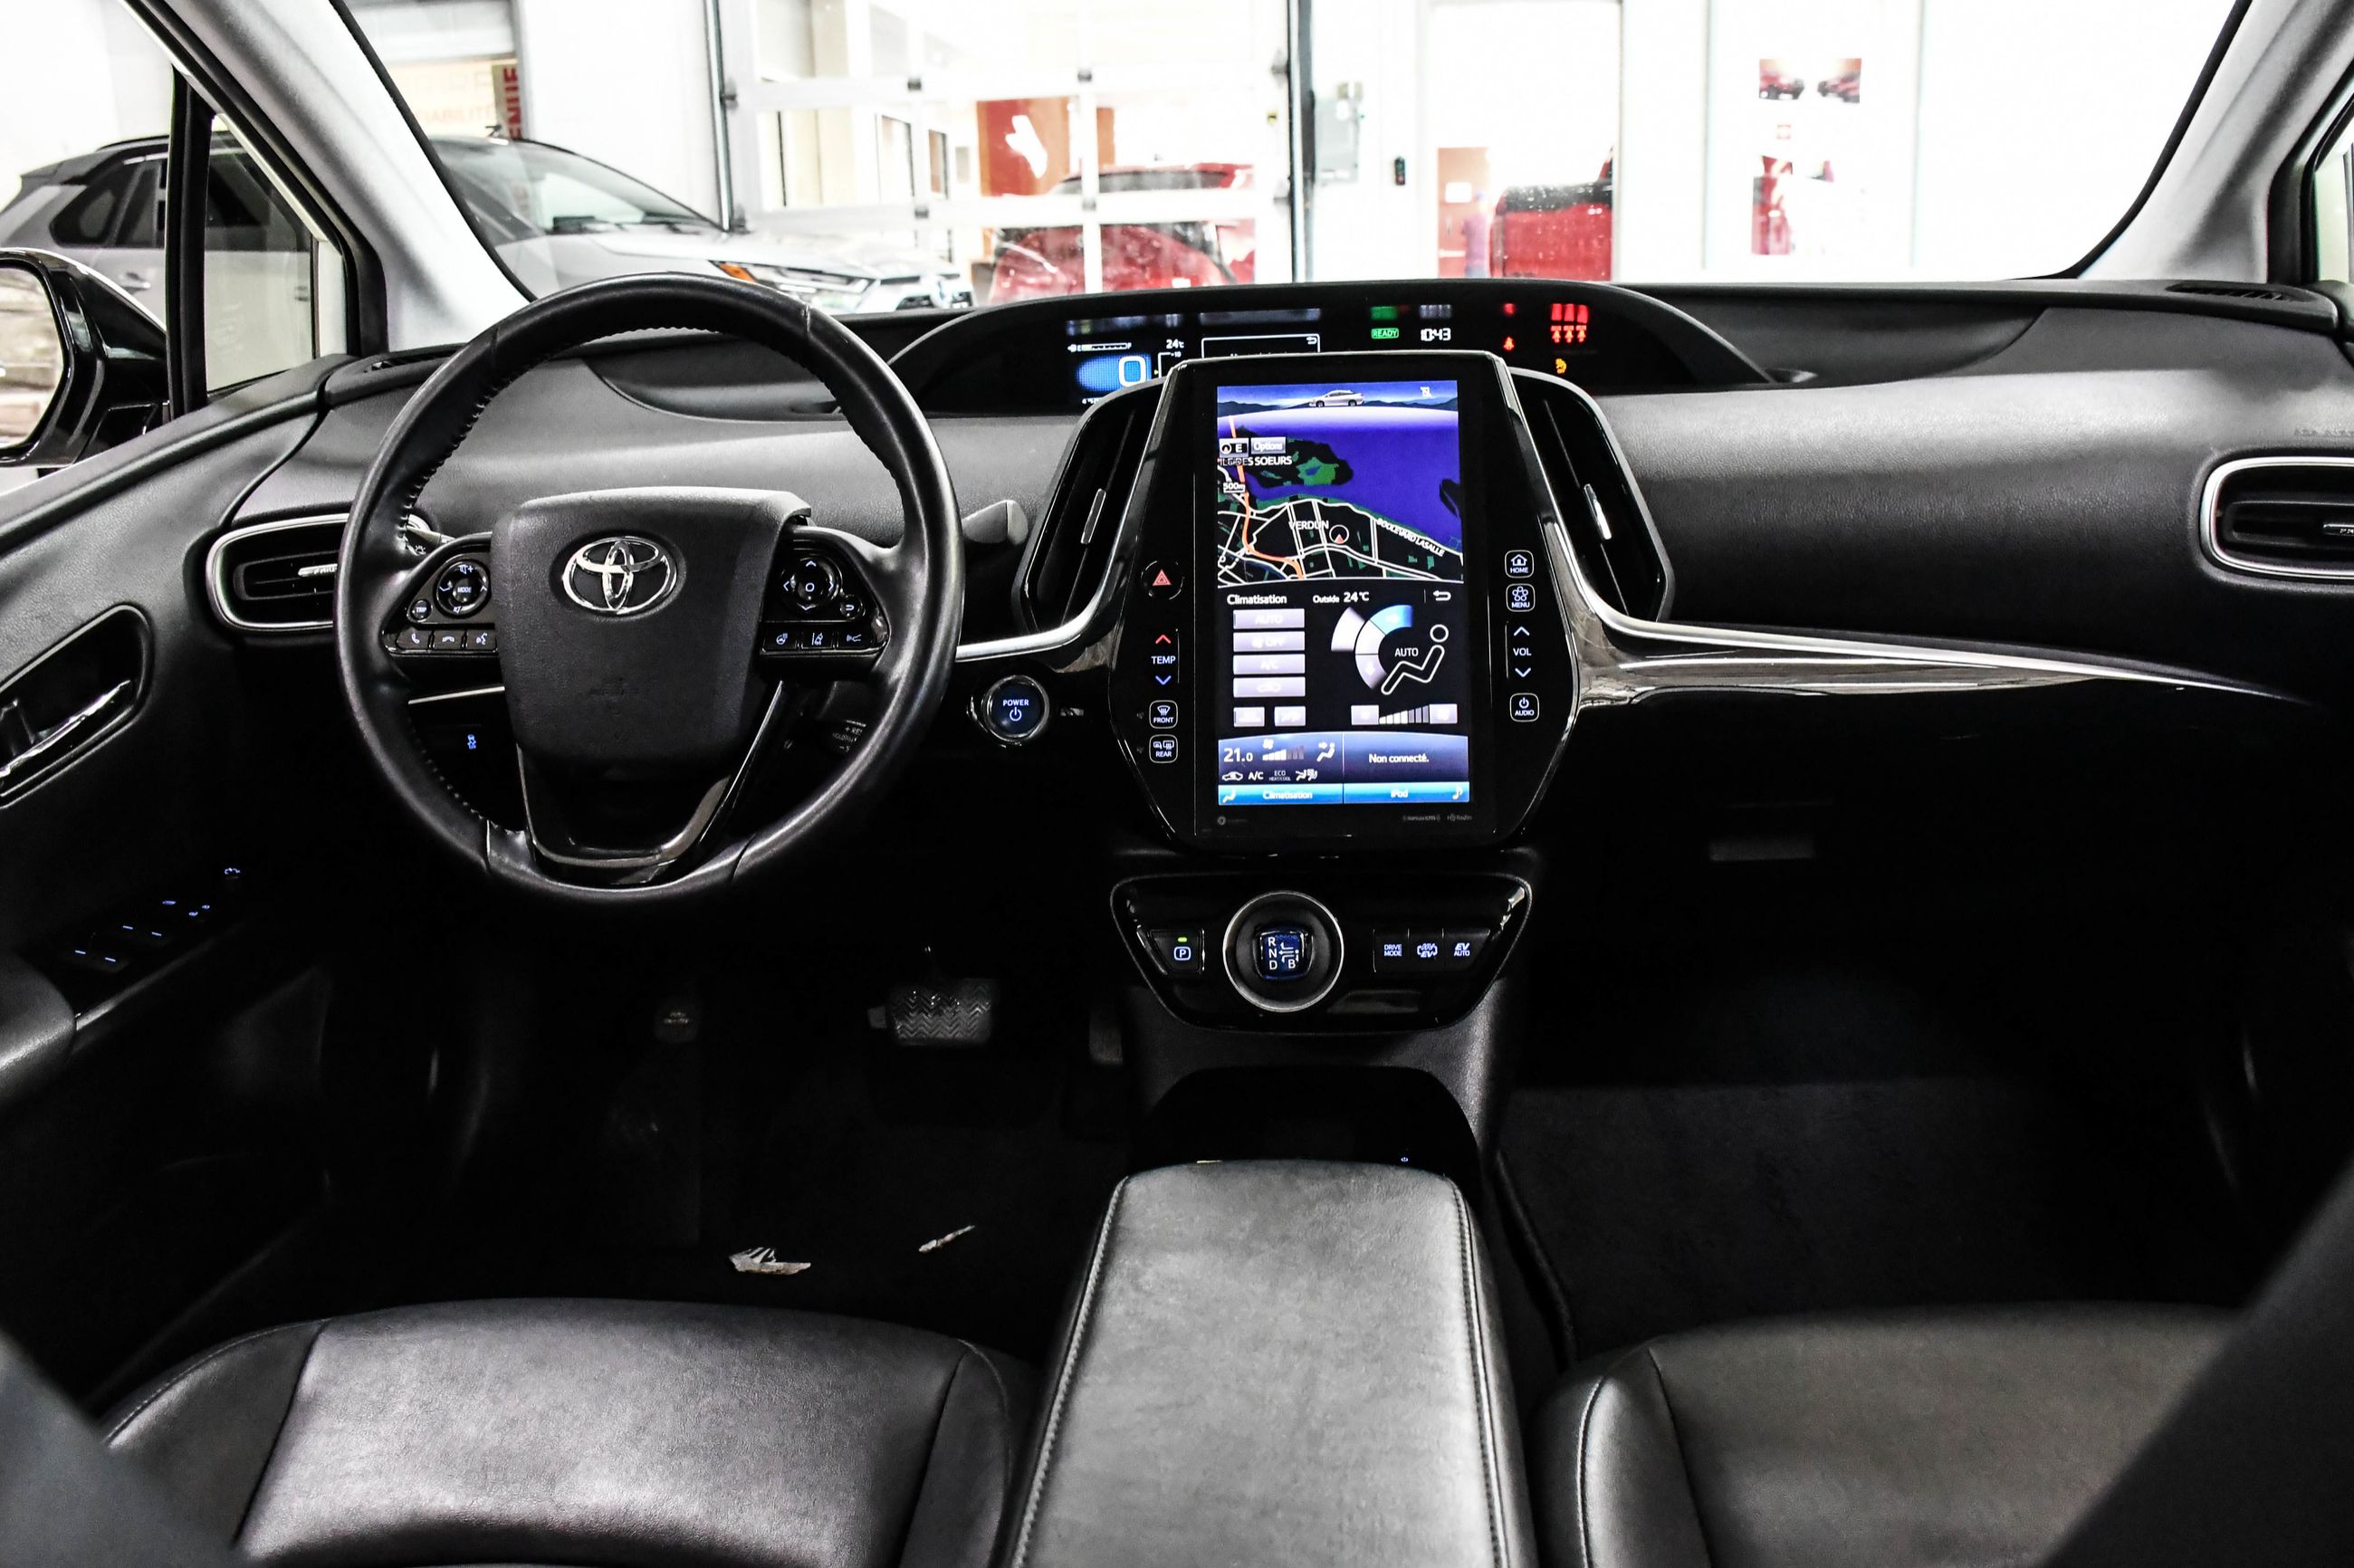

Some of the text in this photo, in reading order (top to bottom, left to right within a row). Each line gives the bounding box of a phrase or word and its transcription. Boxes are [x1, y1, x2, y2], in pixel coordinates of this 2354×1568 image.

[1373, 330, 1398, 338] READY
[1119, 355, 1147, 387] 0
[1235, 443, 1243, 453] E
[1254, 443, 1283, 453] Options
[1254, 455, 1293, 466] SOEURS
[1223, 482, 1246, 491] 500m
[1288, 520, 1329, 531] VERDUN
[1415, 537, 1446, 557] LASALLE
[457, 586, 472, 594] MODE
[1227, 594, 1287, 606] Climatisation
[1313, 595, 1340, 604] Outside
[1394, 647, 1419, 657] AUTO
[1513, 647, 1532, 656] VOL
[1151, 655, 1176, 664] TEMP
[1223, 748, 1254, 762] 21.0
[1368, 752, 1430, 763] Non connecté.
[1249, 770, 1264, 780] A/C
[1262, 789, 1313, 800] Climatisation
[1391, 789, 1409, 798] iPod
[1268, 936, 1277, 947] R
[1455, 942, 1470, 951] EV
[1179, 949, 1187, 958] P
[1268, 948, 1277, 959] N
[1269, 960, 1278, 970] D
[1288, 959, 1297, 969] B
